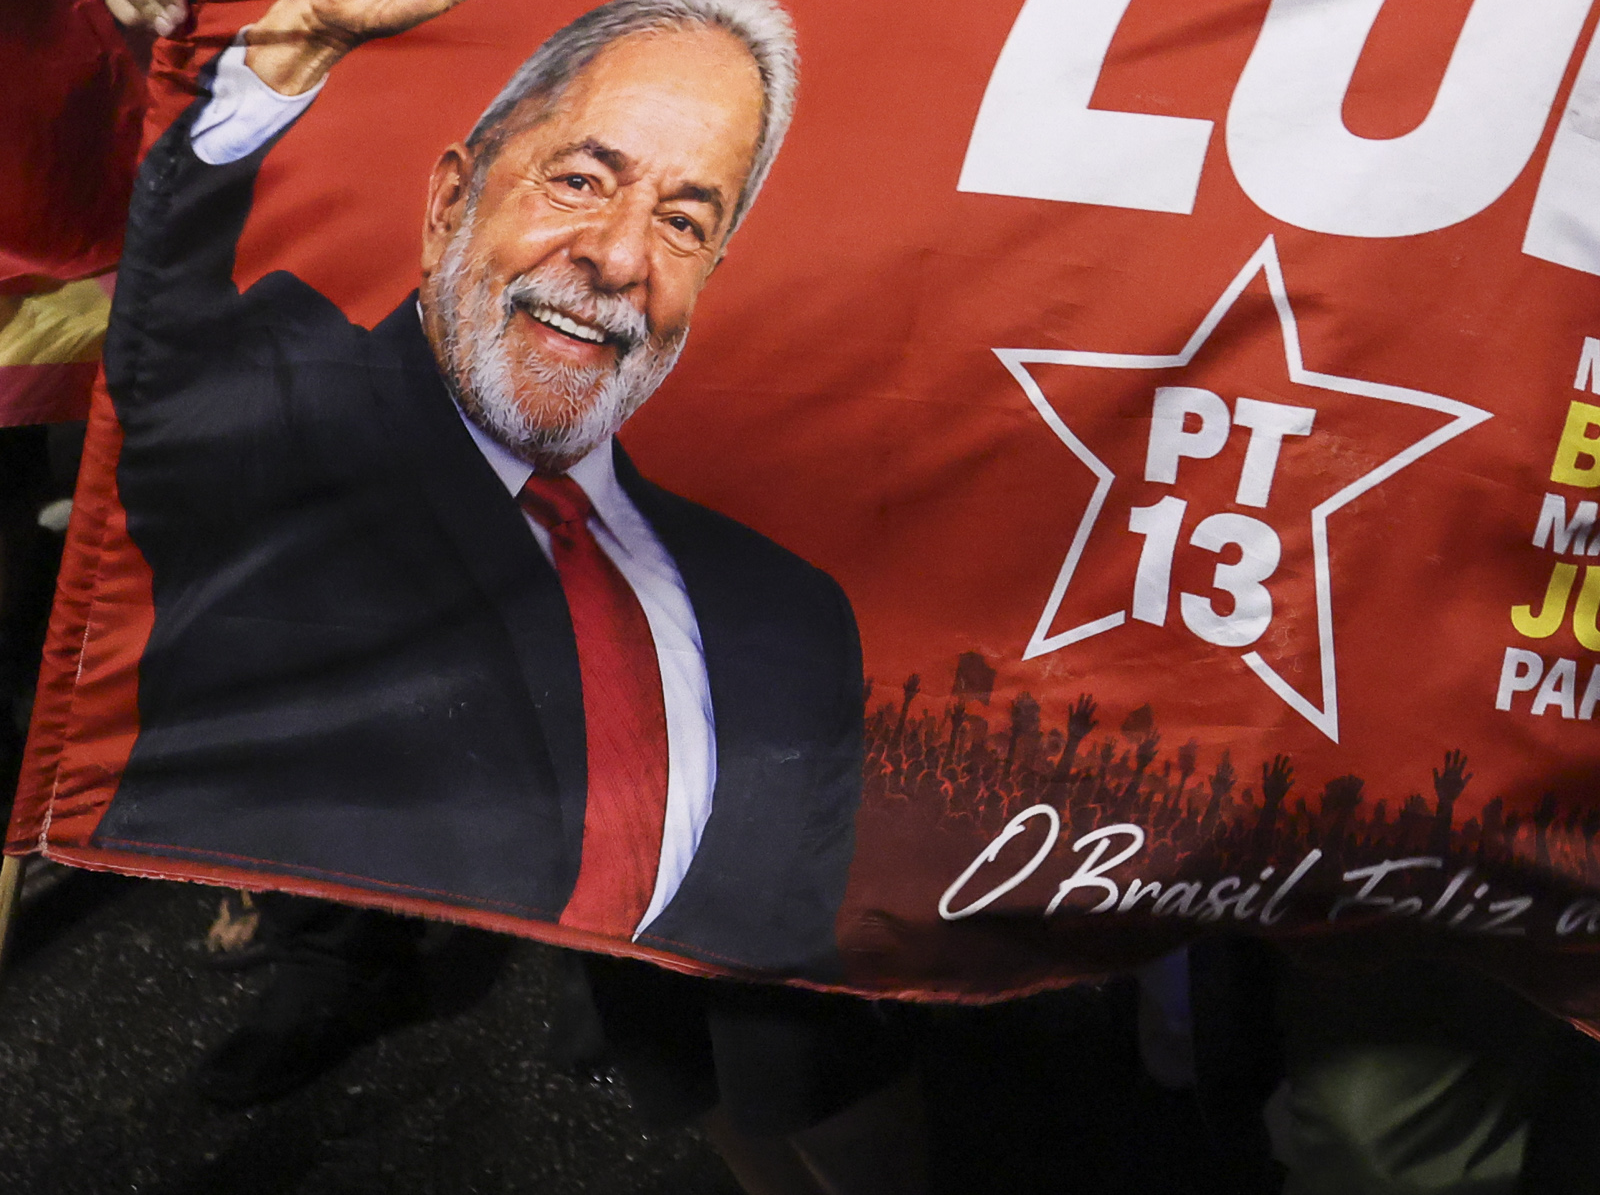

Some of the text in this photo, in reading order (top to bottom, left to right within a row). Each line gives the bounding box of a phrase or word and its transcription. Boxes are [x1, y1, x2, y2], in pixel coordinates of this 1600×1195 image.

[1144, 387, 1317, 509] PT
[1128, 494, 1282, 648] 13
[937, 803, 1060, 921] O
[1043, 822, 1323, 926] Brasil
